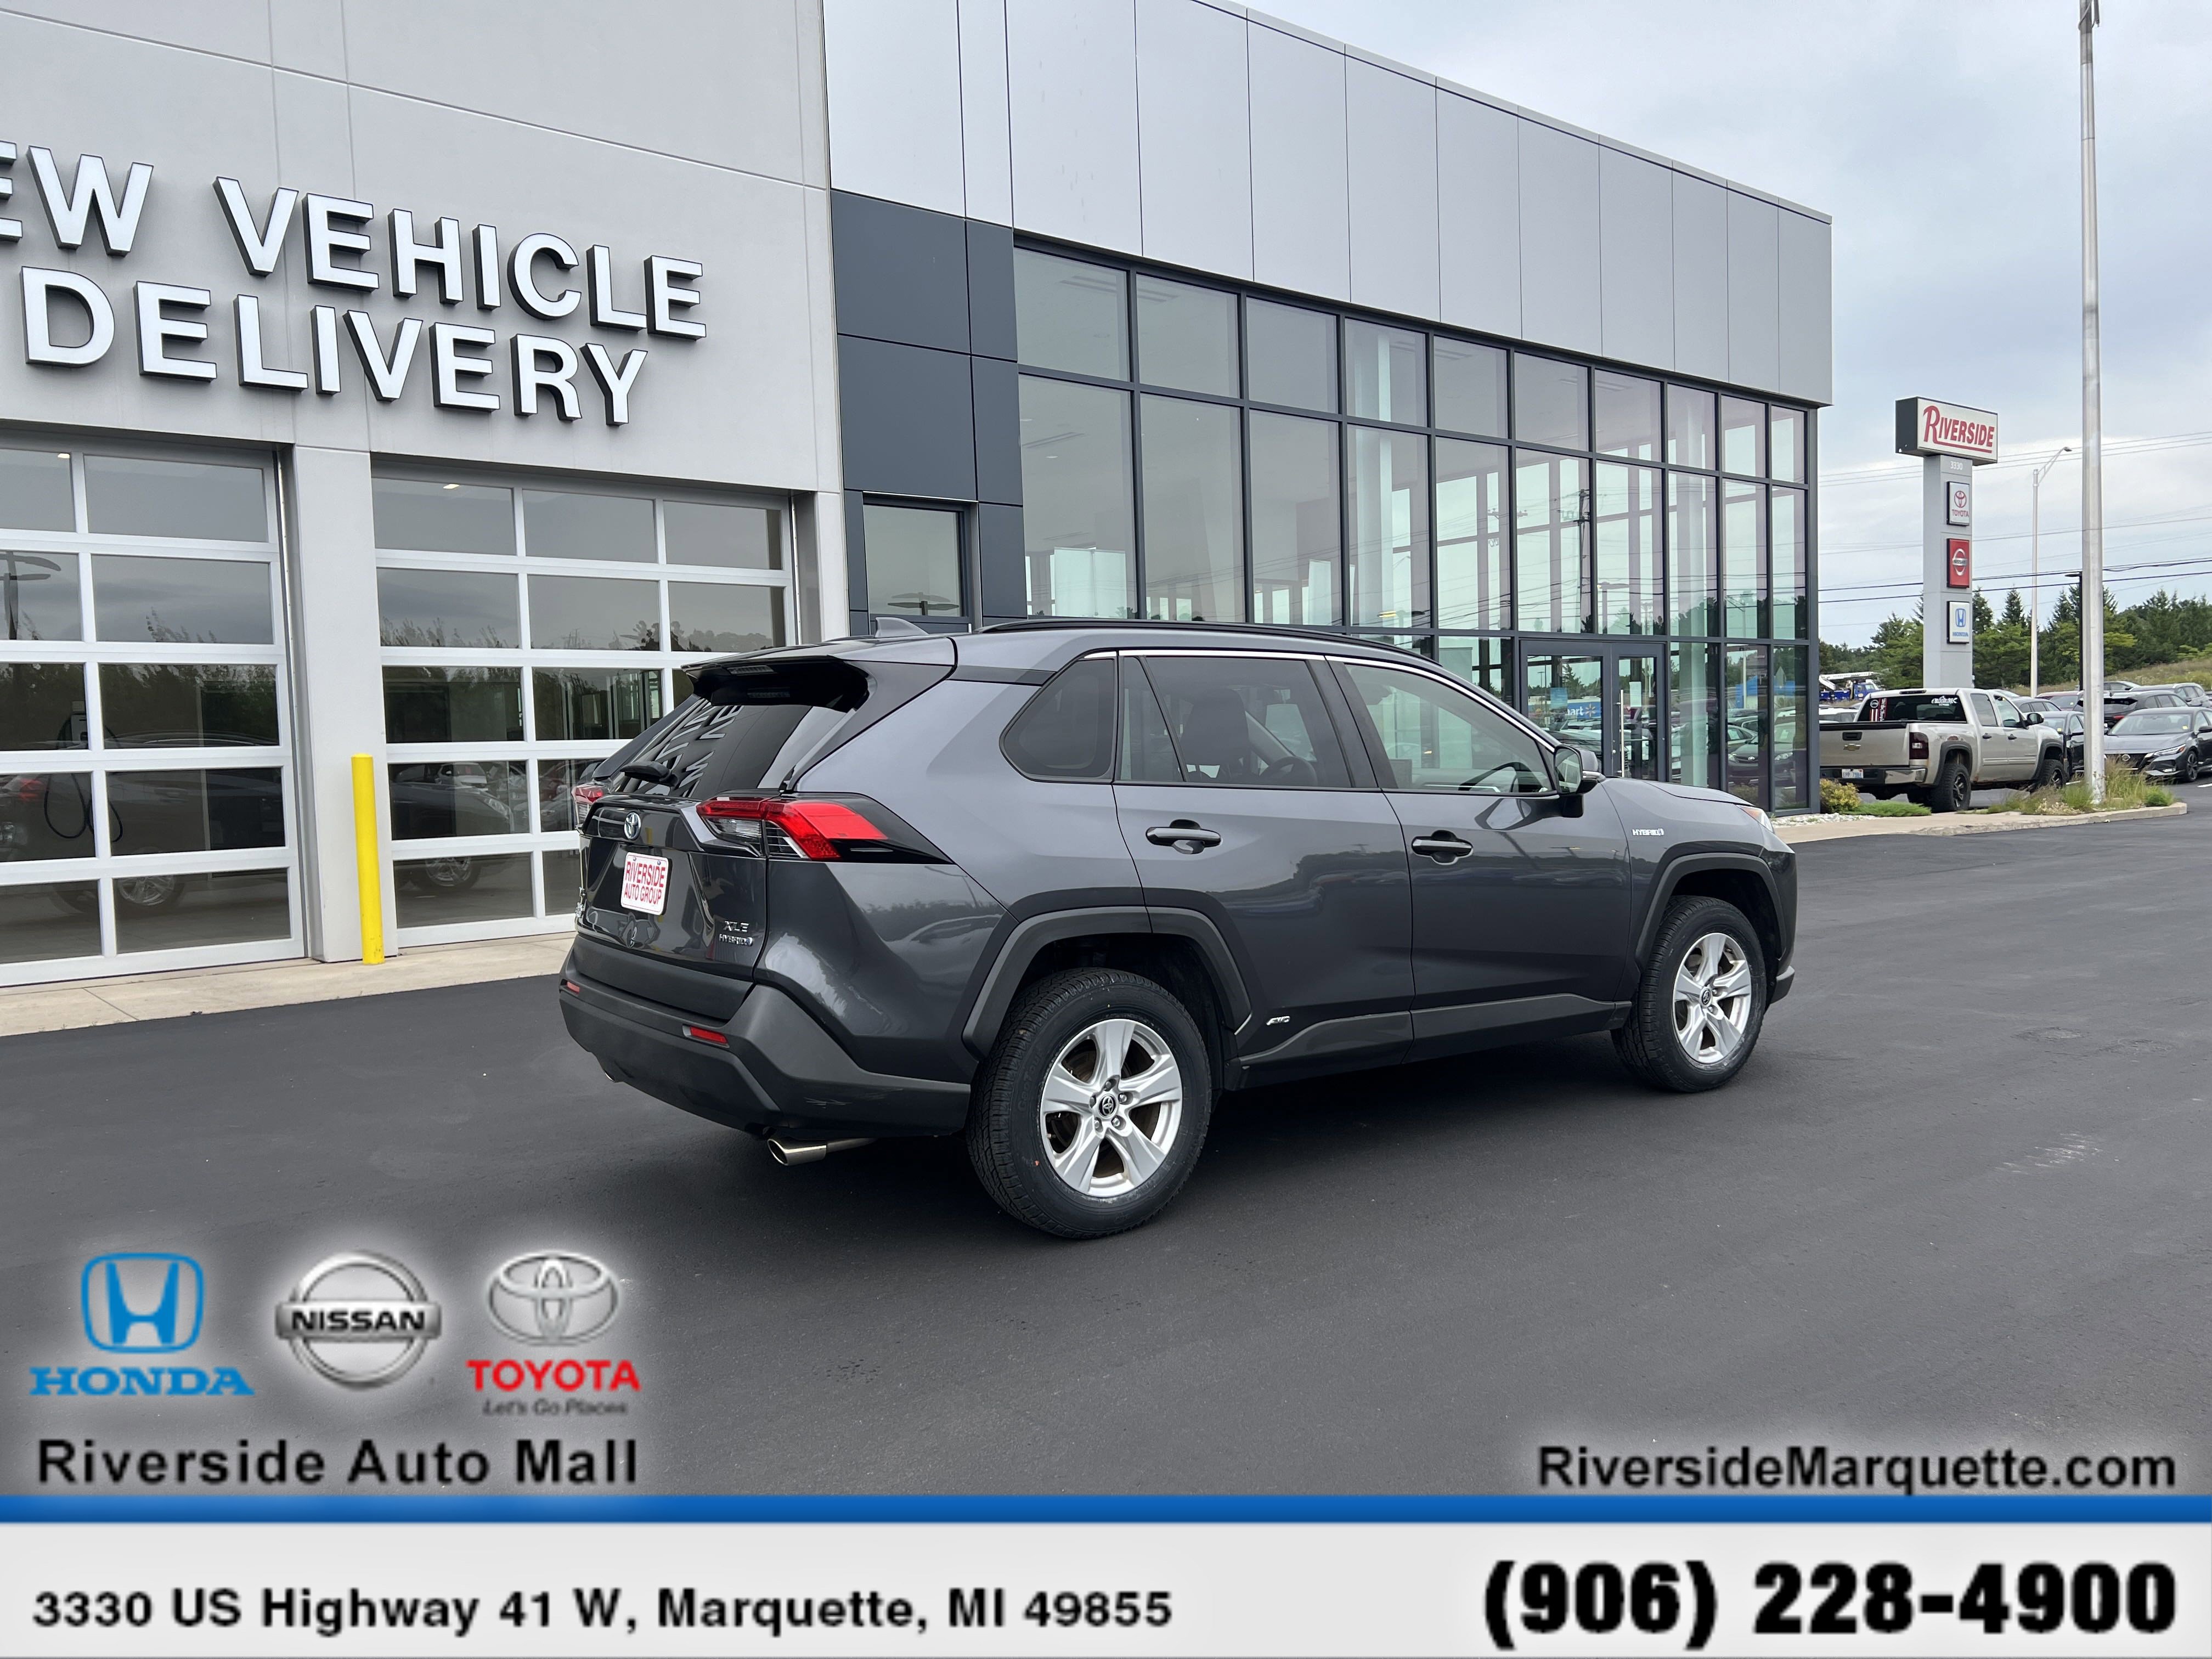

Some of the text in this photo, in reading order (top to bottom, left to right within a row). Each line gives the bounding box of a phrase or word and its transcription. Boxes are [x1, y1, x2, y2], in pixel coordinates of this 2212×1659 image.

[213, 176, 707, 340] VEHICLE
[19, 266, 648, 426] DELIVERY
[1923, 405, 1995, 449] RIVERSIDE
[1950, 461, 1963, 470] 3330
[1952, 509, 1970, 517] TOYOTA
[625, 861, 665, 888] RIVERSIDE
[624, 883, 662, 904] AUTO GROUP
[723, 921, 749, 932] XLE
[719, 934, 754, 946] HYBRID
